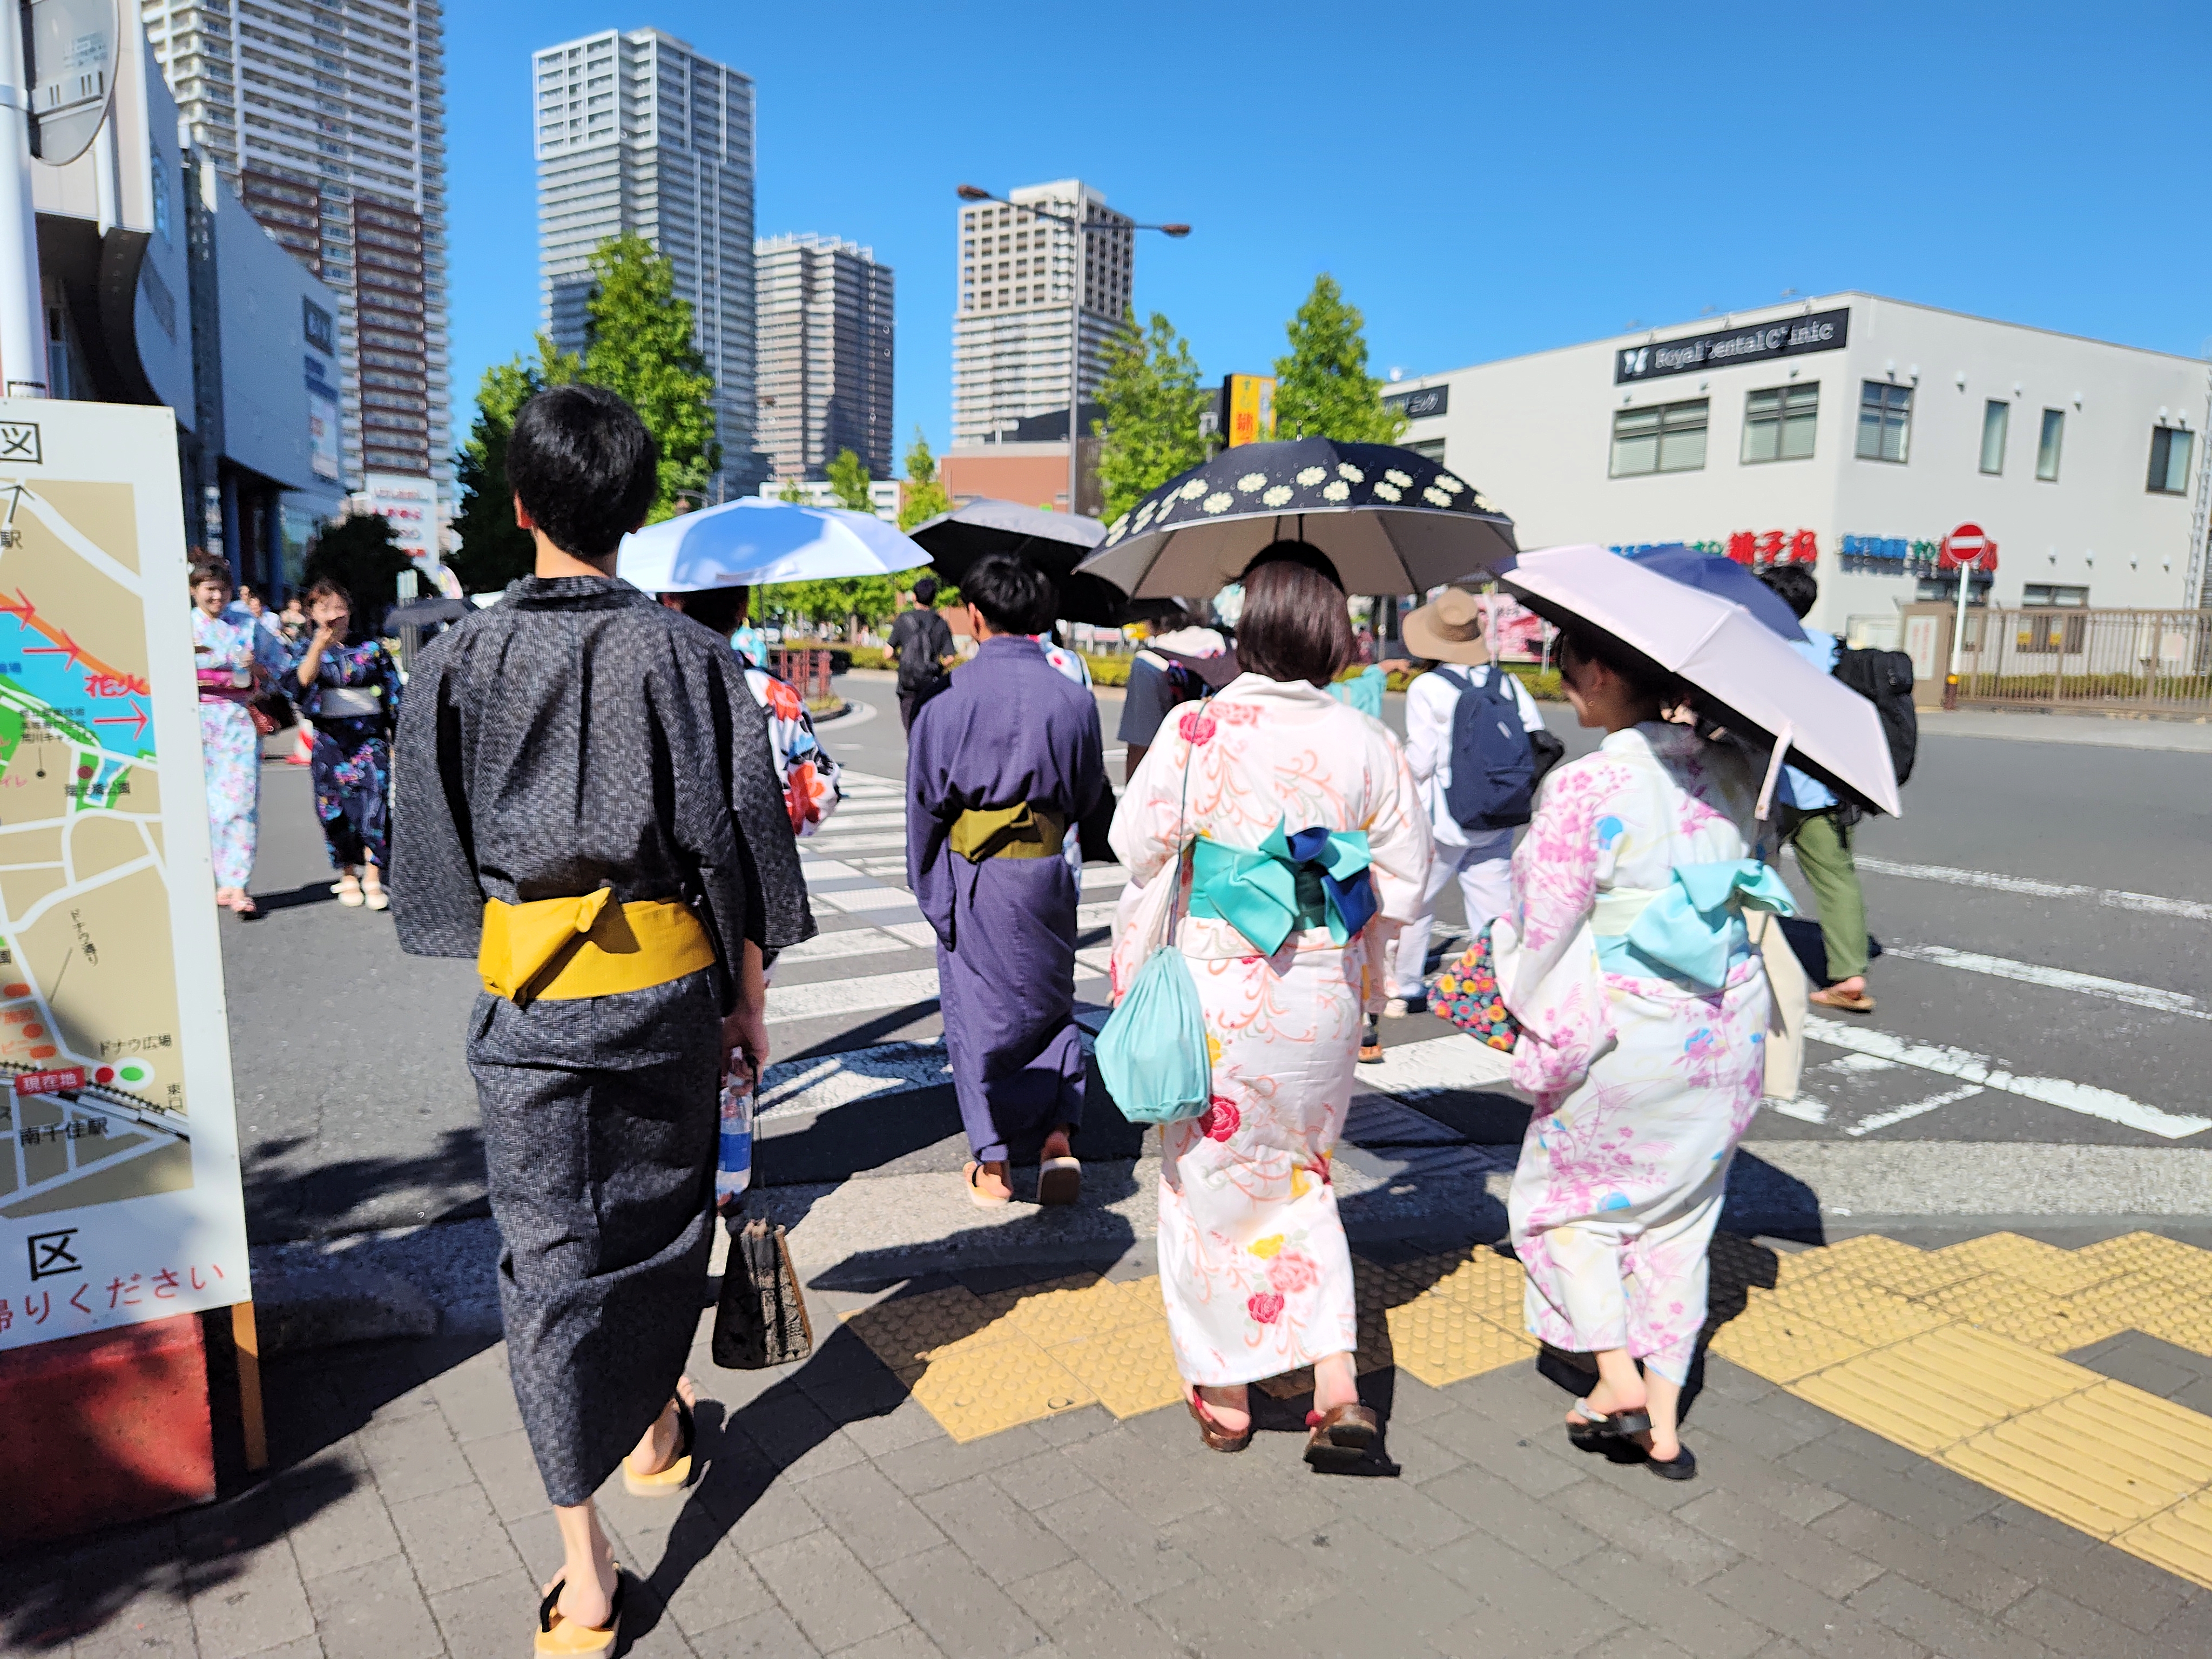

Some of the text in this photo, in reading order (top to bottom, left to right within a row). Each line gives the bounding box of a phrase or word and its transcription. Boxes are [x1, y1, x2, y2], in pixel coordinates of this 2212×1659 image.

[1655, 340, 1706, 370] Royal
[0, 530, 23, 550] 駅
[84, 674, 151, 698] 花火
[99, 1033, 172, 1057] ドナウ広場
[23, 1073, 77, 1093] 現在地
[20, 1116, 108, 1147] 南千住駅
[27, 1228, 82, 1281] 区
